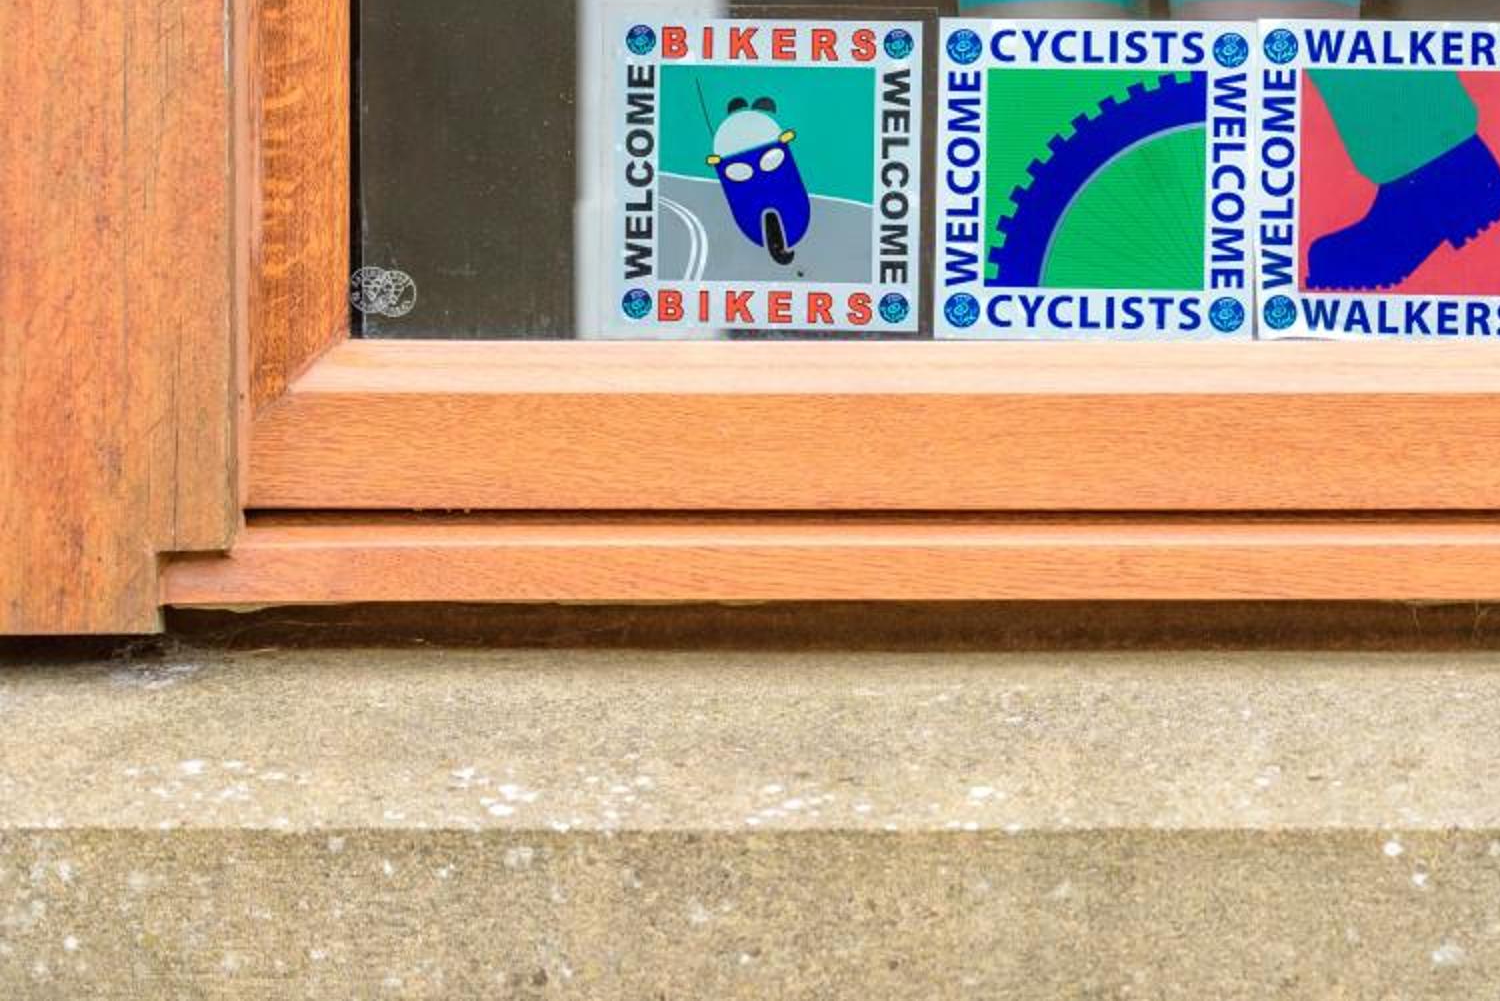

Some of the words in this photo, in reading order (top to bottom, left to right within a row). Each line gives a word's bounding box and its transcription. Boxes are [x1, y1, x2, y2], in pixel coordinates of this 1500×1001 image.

[661, 26, 877, 62] BIKERS
[990, 29, 1206, 64] CYCLISTS
[624, 64, 655, 280] WELCOME
[879, 69, 911, 285] WELCOME
[945, 70, 981, 287] WELCOME
[1210, 73, 1247, 290] WELCOME
[1260, 68, 1296, 290] WELCOME
[657, 289, 874, 326] BIKERS
[986, 294, 1201, 331] CYCLISTS
